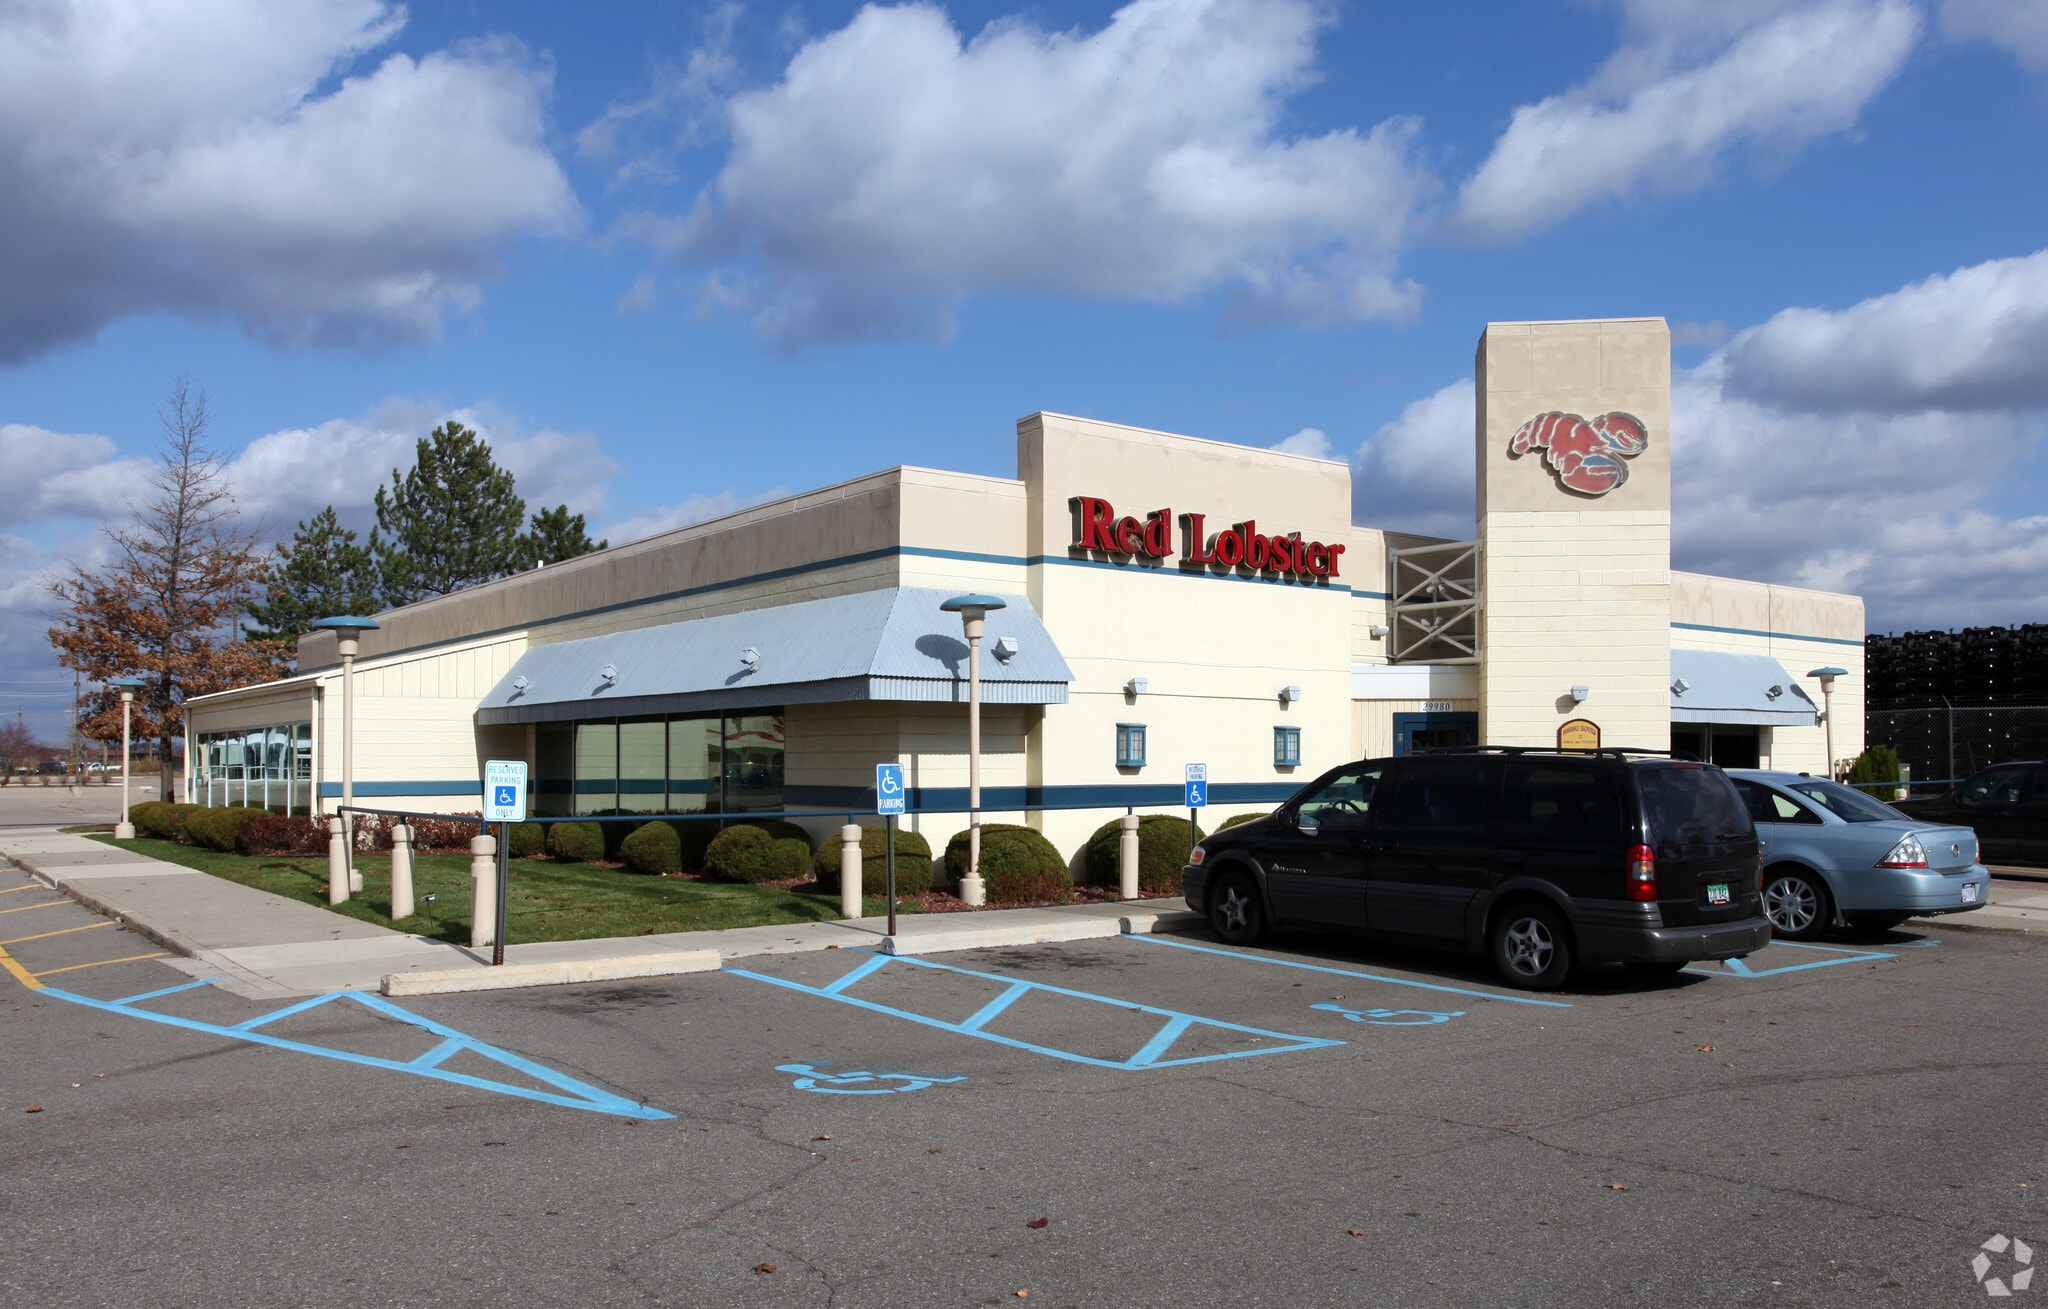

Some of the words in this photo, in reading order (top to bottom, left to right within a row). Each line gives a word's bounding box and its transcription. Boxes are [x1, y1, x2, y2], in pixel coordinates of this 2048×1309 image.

[1069, 496, 1174, 558] Red
[1180, 513, 1346, 577] Lobster
[1422, 702, 1450, 711] 29980
[488, 765, 524, 775] RESERVED
[490, 776, 521, 785] PARKING
[879, 798, 903, 809] PARKING
[495, 808, 514, 817] ONLY
